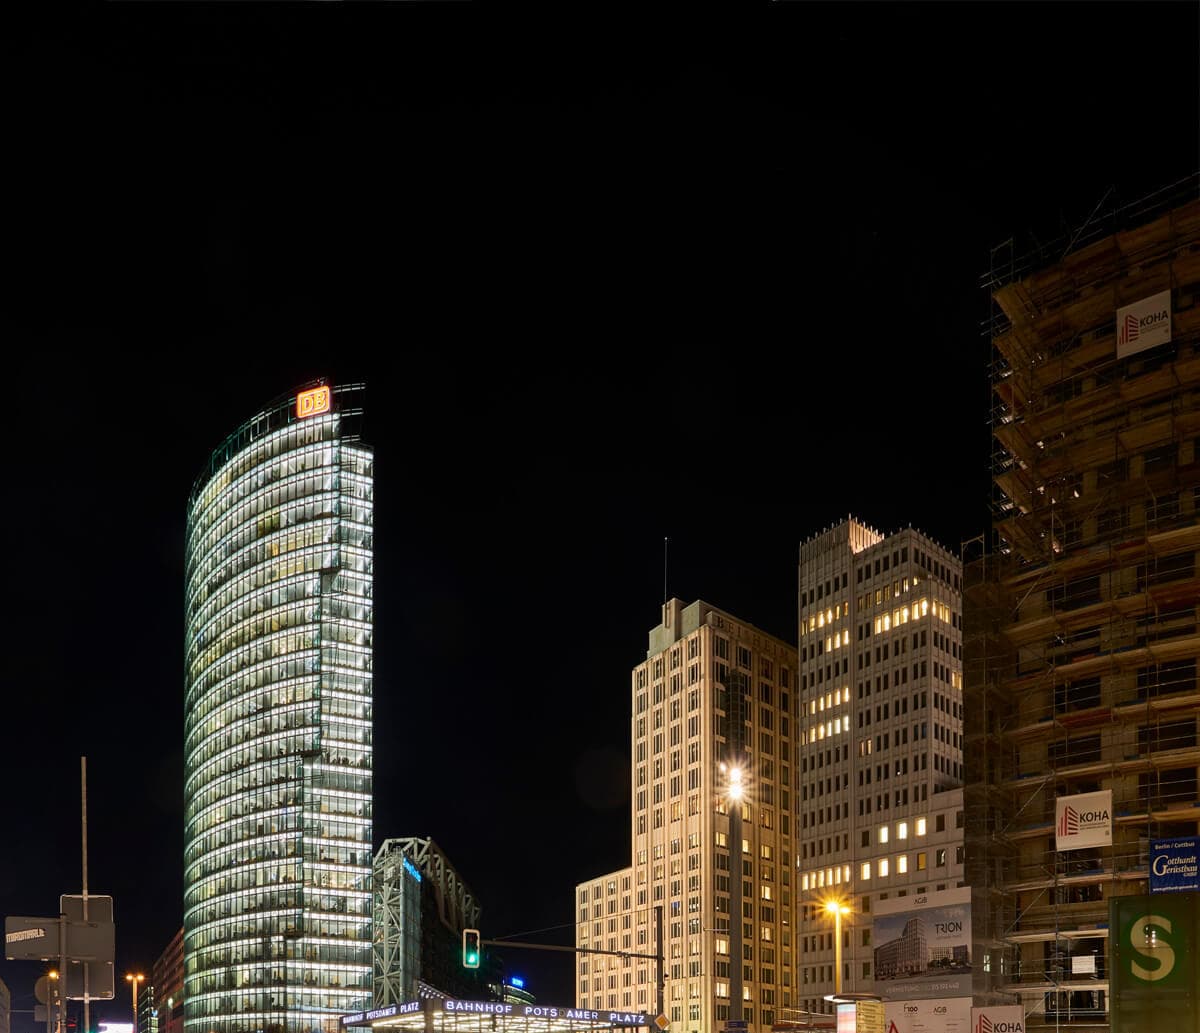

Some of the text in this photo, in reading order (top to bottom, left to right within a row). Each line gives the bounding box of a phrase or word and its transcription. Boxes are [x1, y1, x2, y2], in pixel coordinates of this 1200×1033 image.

[1140, 311, 1169, 327] KOHA
[301, 391, 326, 413] DB
[1079, 811, 1109, 822] KOHA
[936, 921, 962, 935] TRION
[1130, 915, 1175, 981] S
[343, 1002, 419, 1024] BAHNHOF POTSDAMER PLATZ
[447, 1001, 645, 1023] BAHNHOF POTSDAMER PLATZ
[994, 1022, 1022, 1033] KOHA
